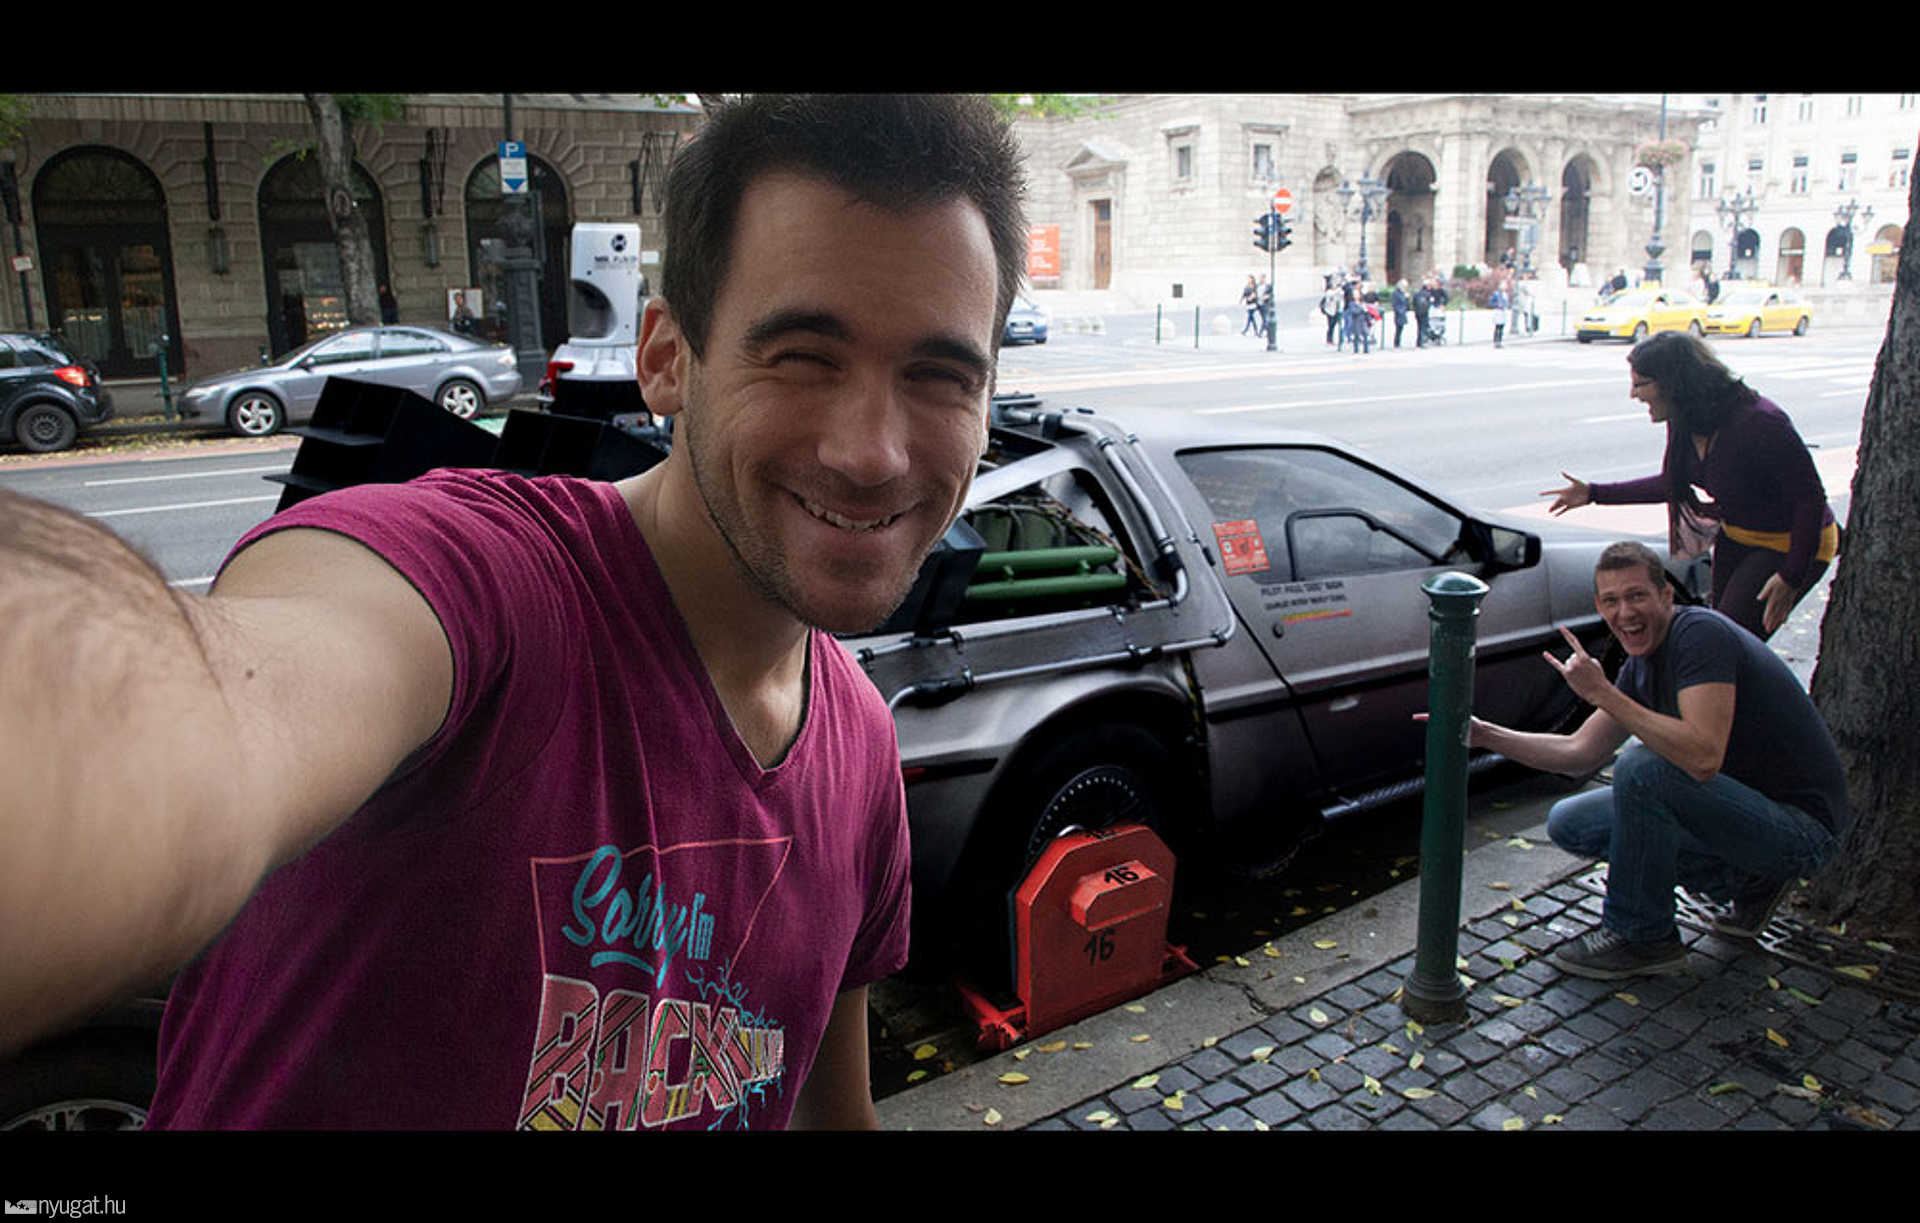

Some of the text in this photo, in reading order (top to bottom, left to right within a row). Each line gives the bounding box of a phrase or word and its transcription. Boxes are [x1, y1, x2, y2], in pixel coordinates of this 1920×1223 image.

[505, 142, 520, 157] P
[1105, 867, 1139, 884] 16
[561, 845, 688, 989] Sorry
[1083, 927, 1115, 966] 16
[516, 973, 738, 1131] BACK
